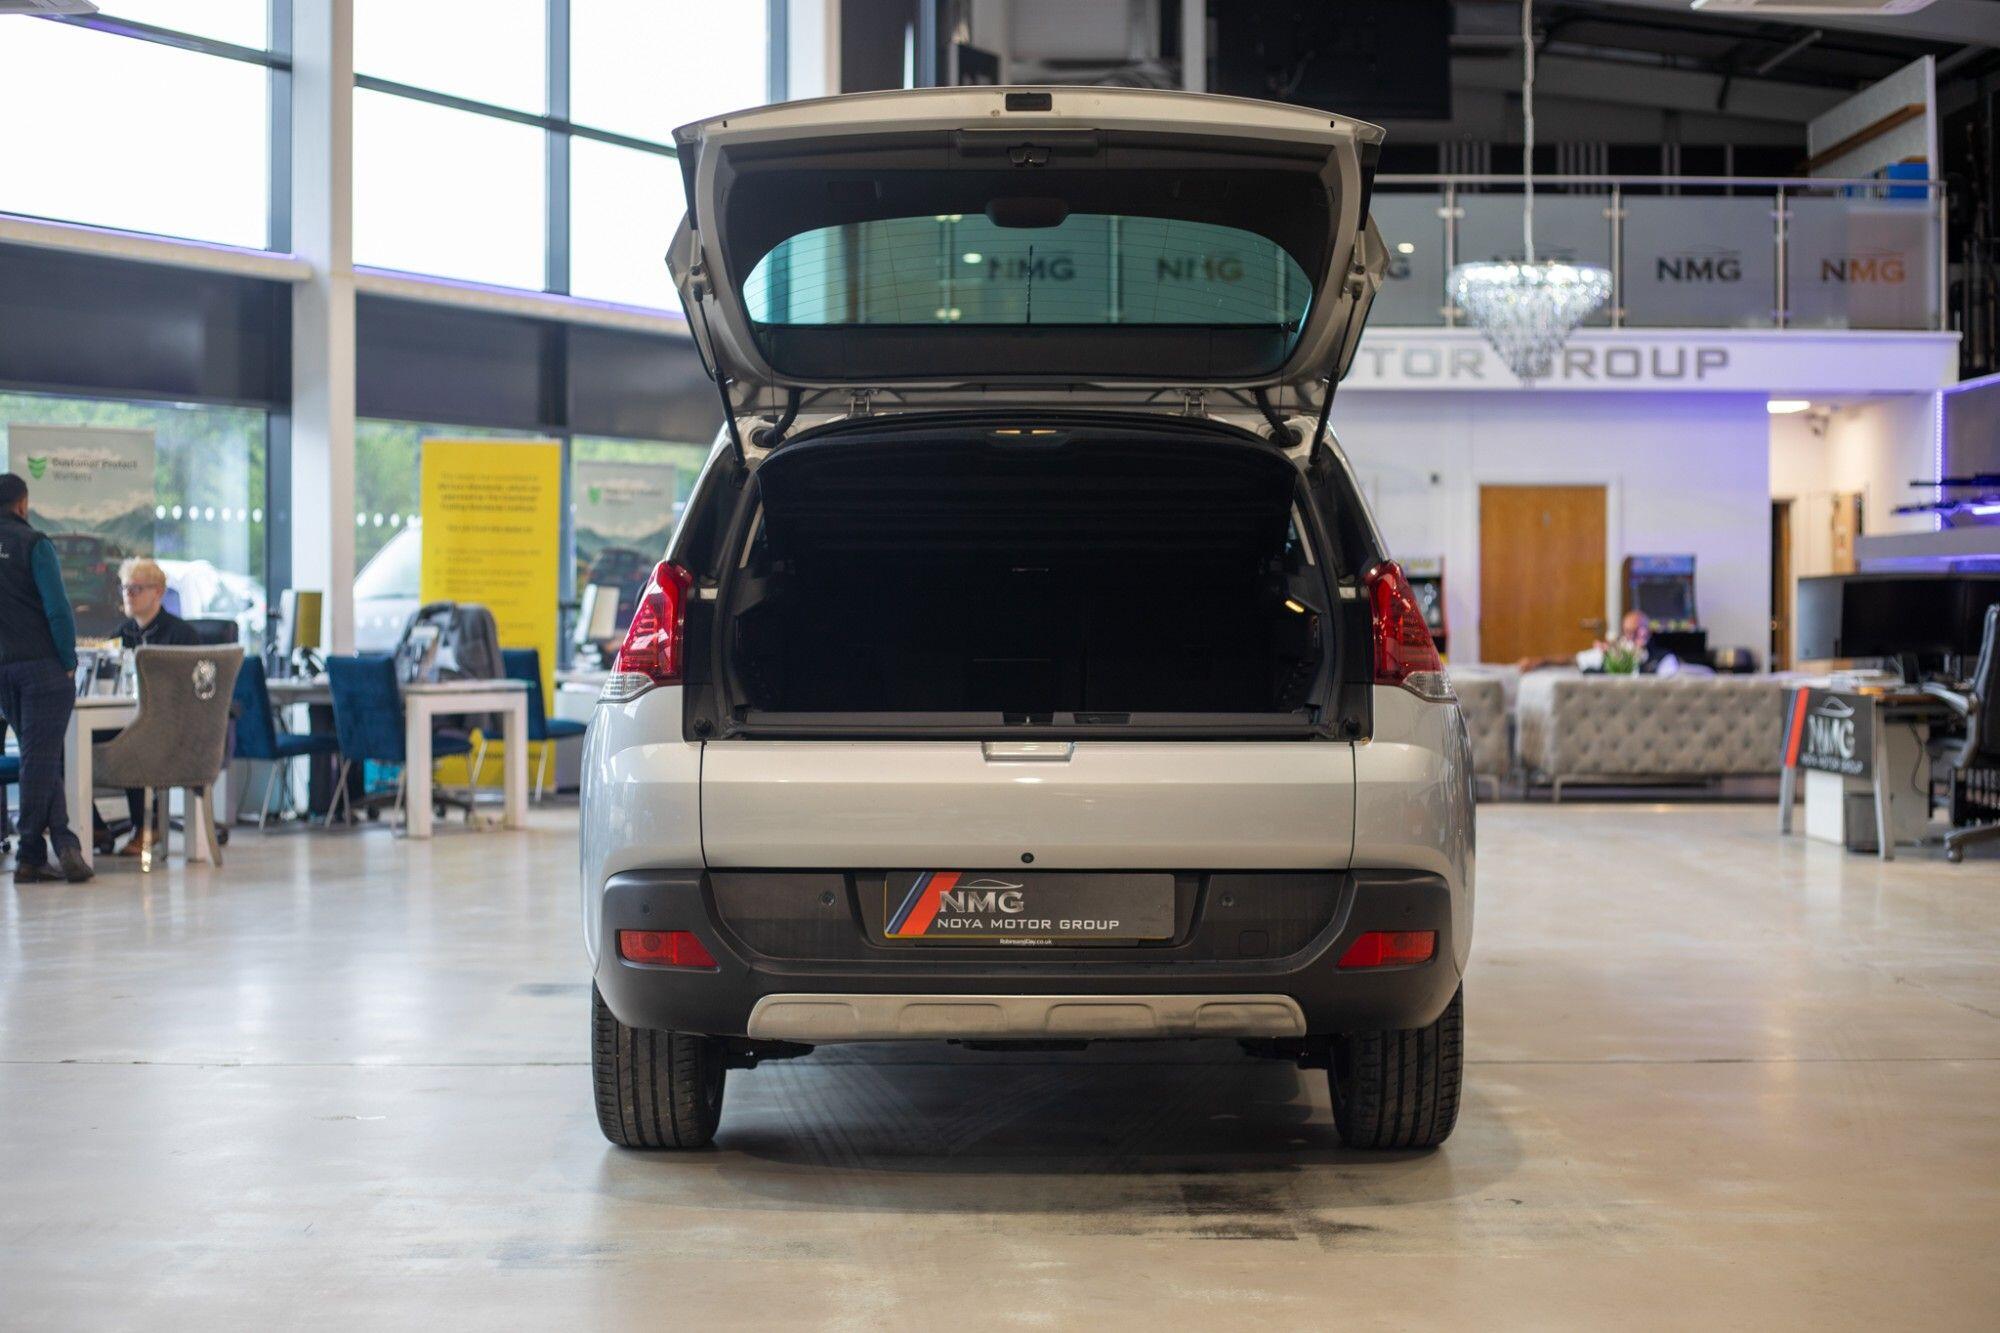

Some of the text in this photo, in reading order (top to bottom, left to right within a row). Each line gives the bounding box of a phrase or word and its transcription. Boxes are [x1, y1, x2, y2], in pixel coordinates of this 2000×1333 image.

[1656, 257, 1742, 282] NMG
[1821, 258, 1907, 284] NMG
[1349, 346, 1486, 378] TOR
[1808, 715, 1856, 759] NMG
[938, 890, 1024, 914] NMG
[937, 918, 1120, 931] NOYA MOTOR GROUP
